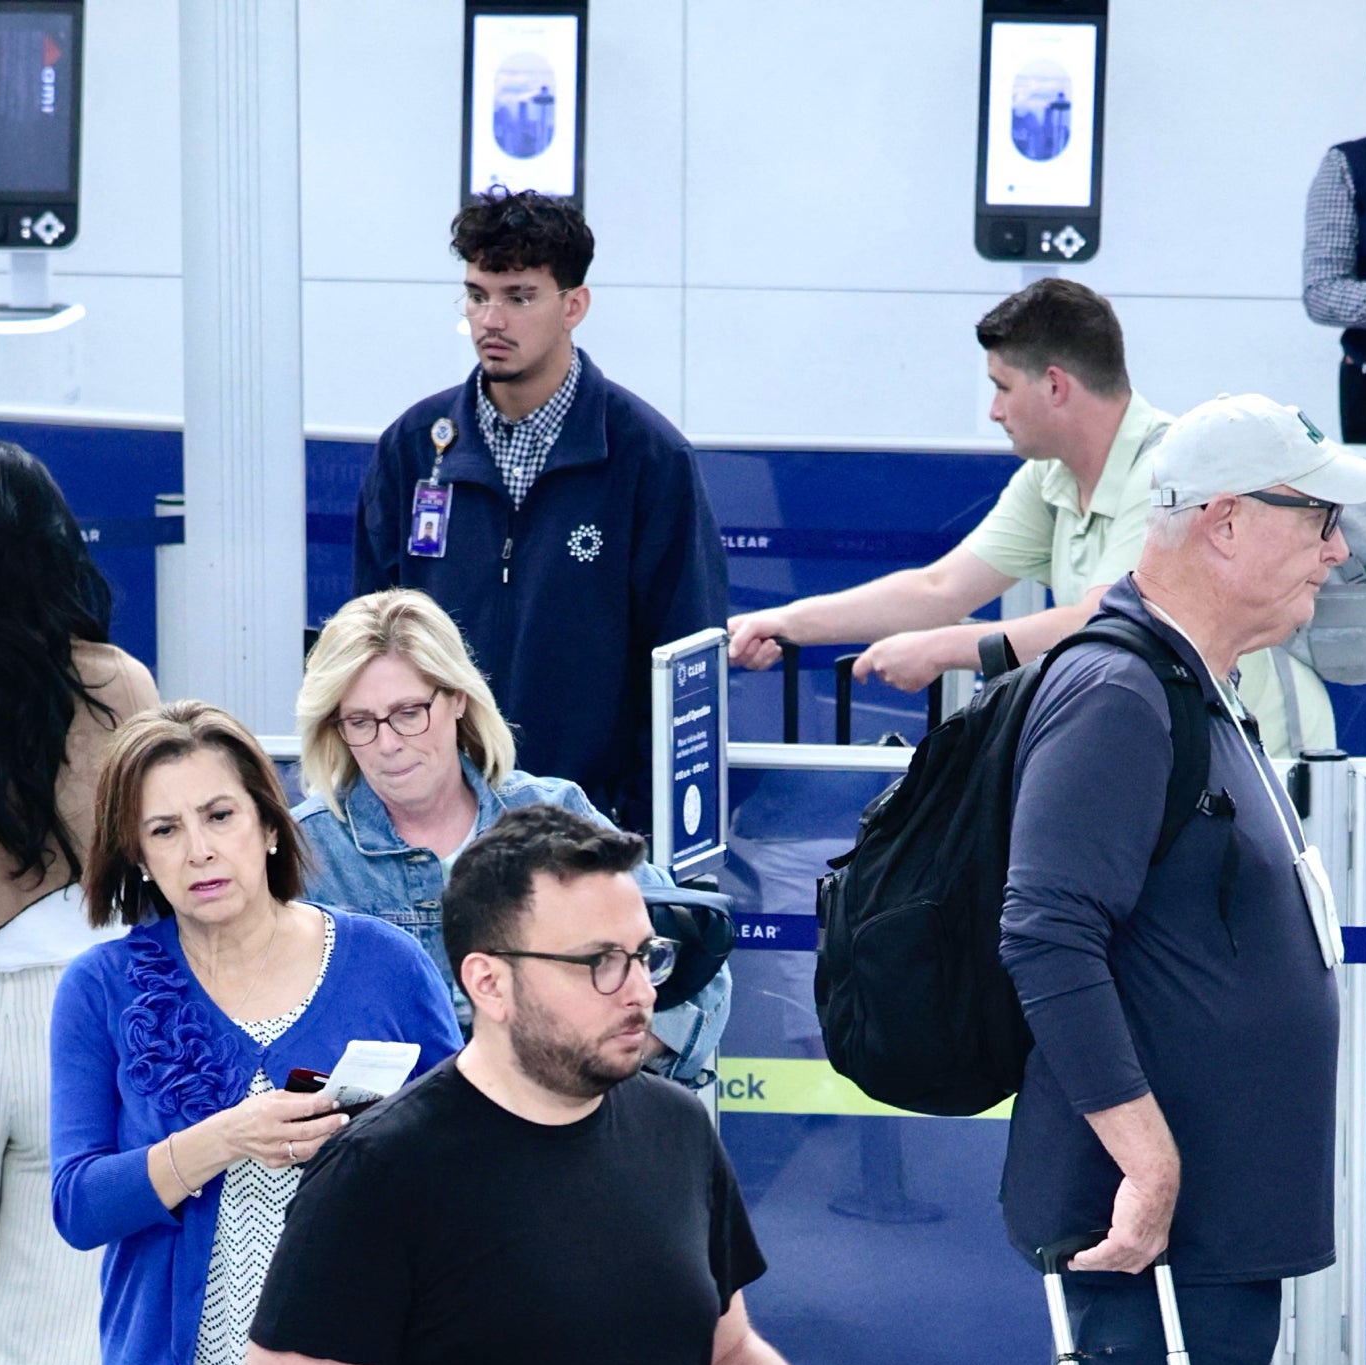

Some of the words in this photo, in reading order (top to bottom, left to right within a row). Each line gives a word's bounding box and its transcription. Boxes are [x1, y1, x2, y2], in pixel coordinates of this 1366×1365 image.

[719, 535, 769, 548] CLEAR
[688, 661, 707, 677] CLEAR
[737, 924, 777, 939] EAR
